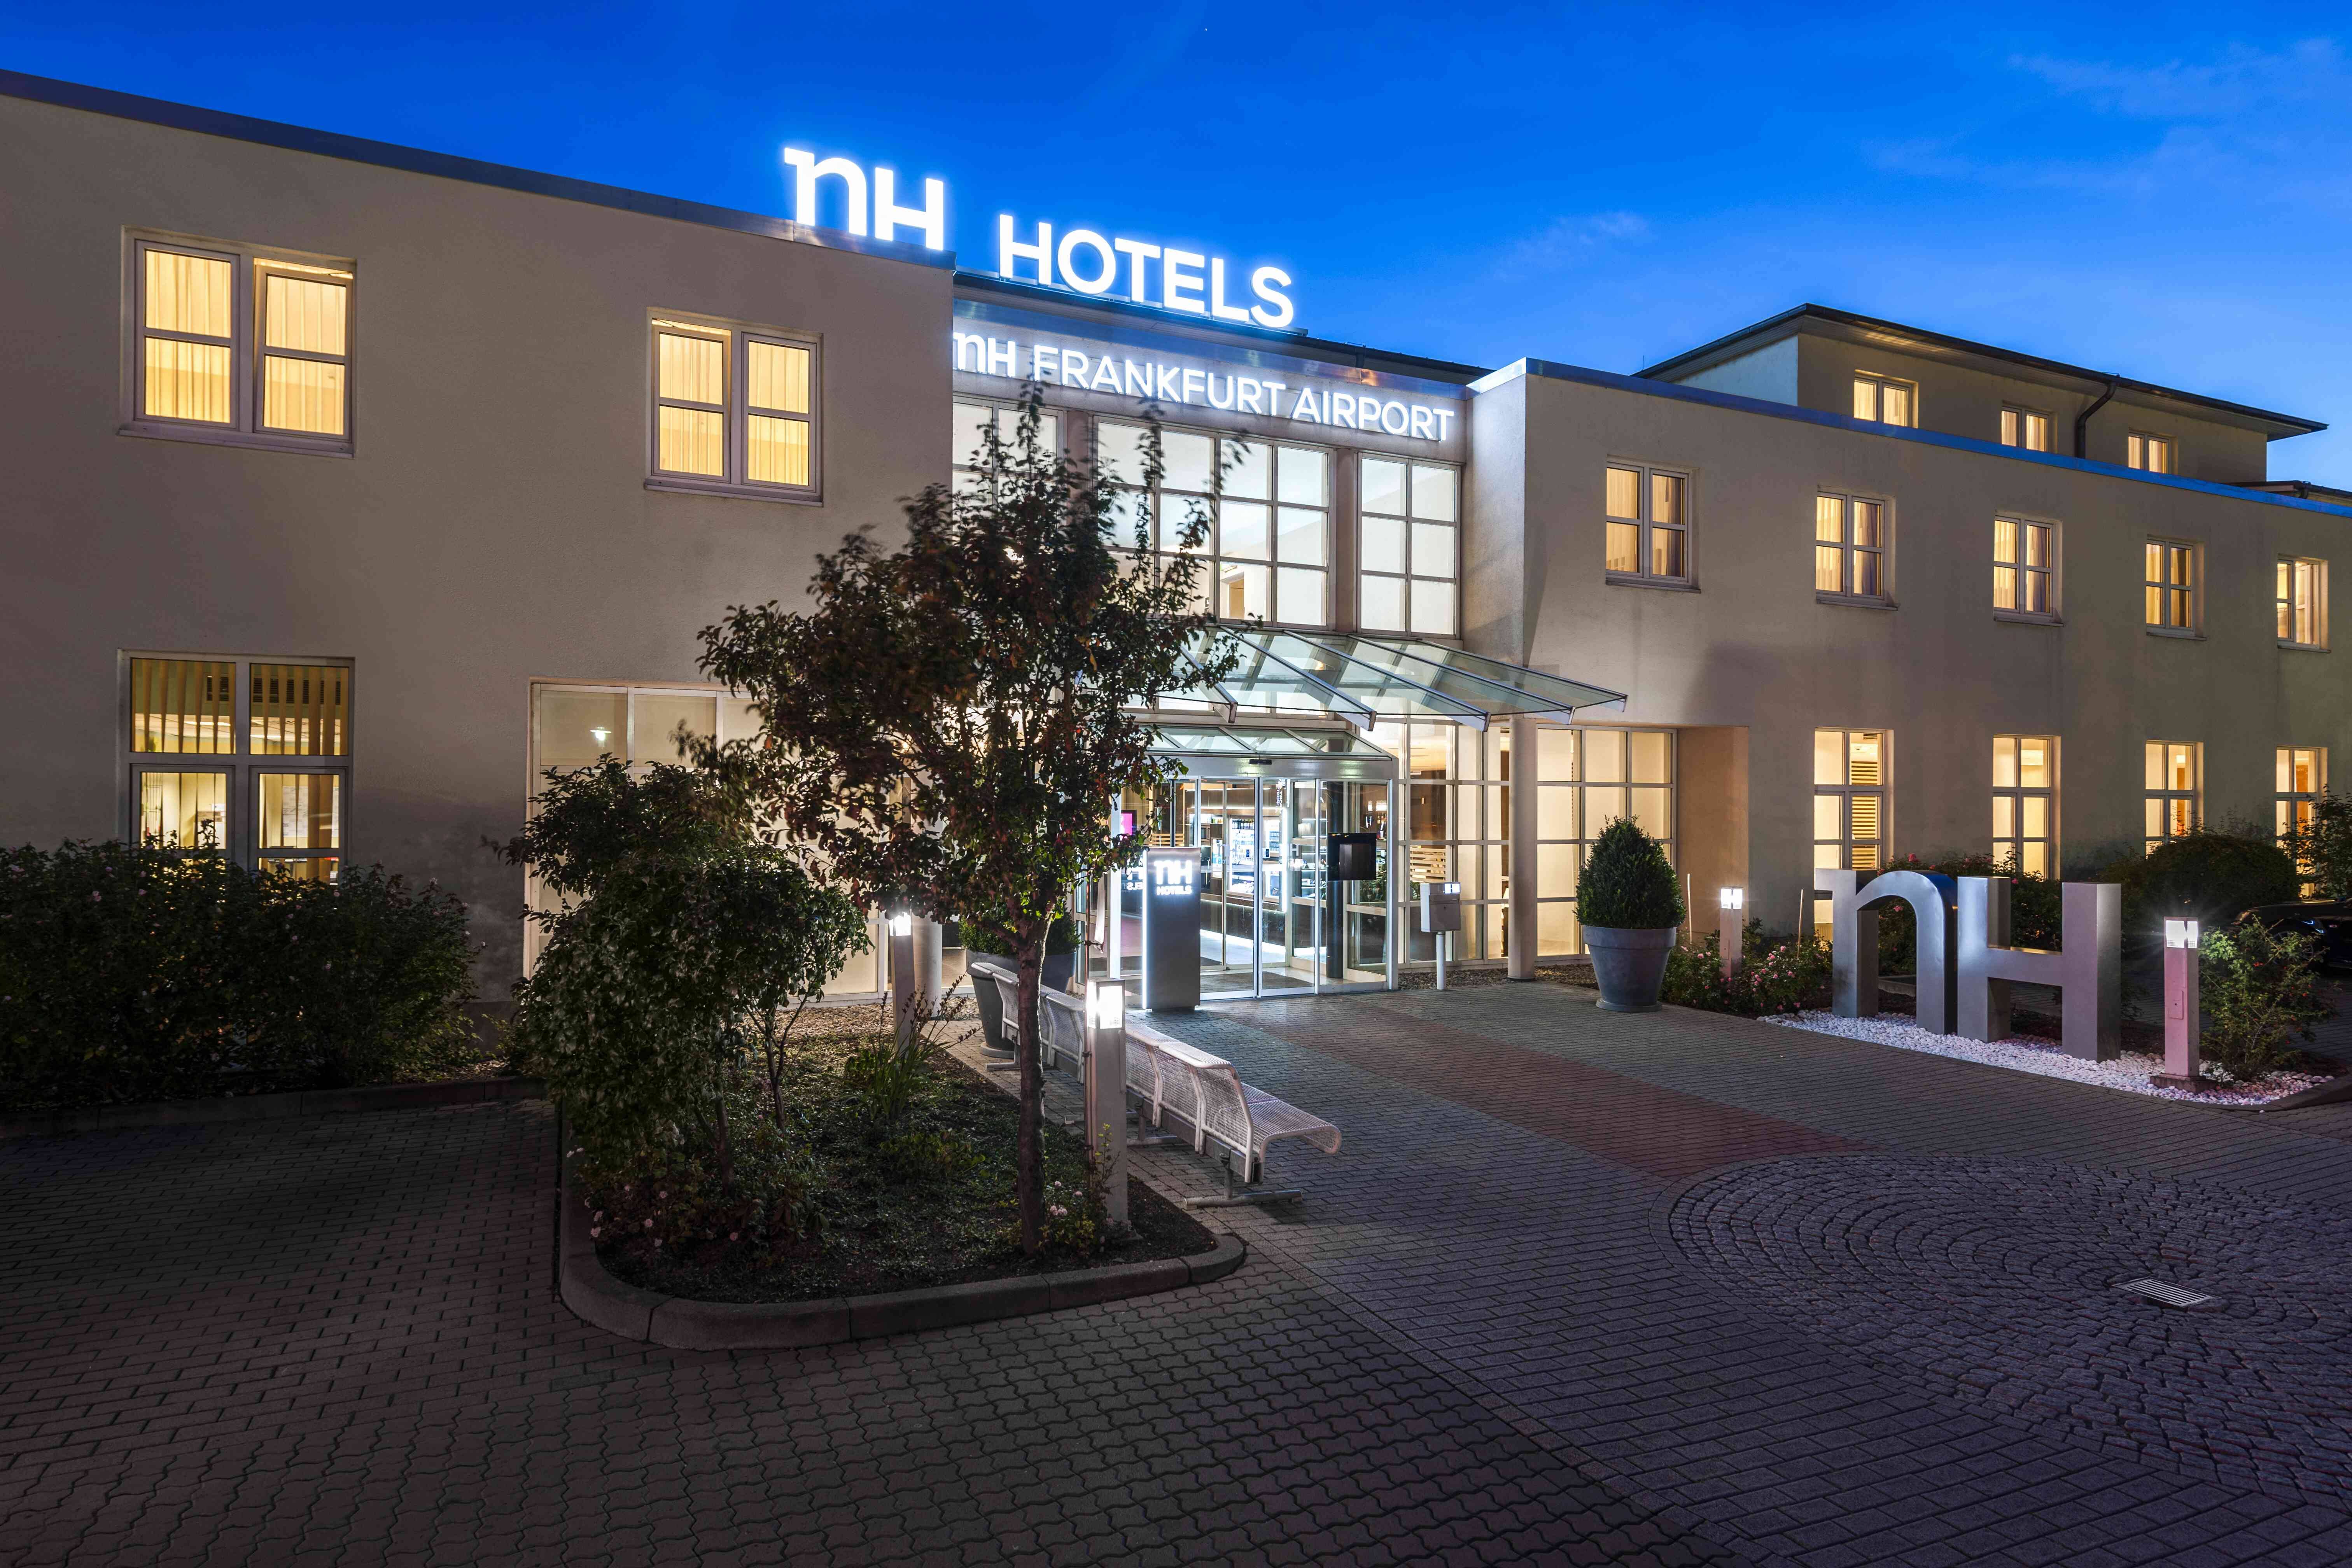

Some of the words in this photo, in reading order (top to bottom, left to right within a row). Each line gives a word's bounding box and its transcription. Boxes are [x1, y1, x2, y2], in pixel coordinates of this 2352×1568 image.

[999, 214, 1294, 328] HOTELS
[1033, 345, 1285, 415] FRANKFURT
[1292, 387, 1455, 441] AIRPORT
[1156, 885, 1192, 895] HOTELS
